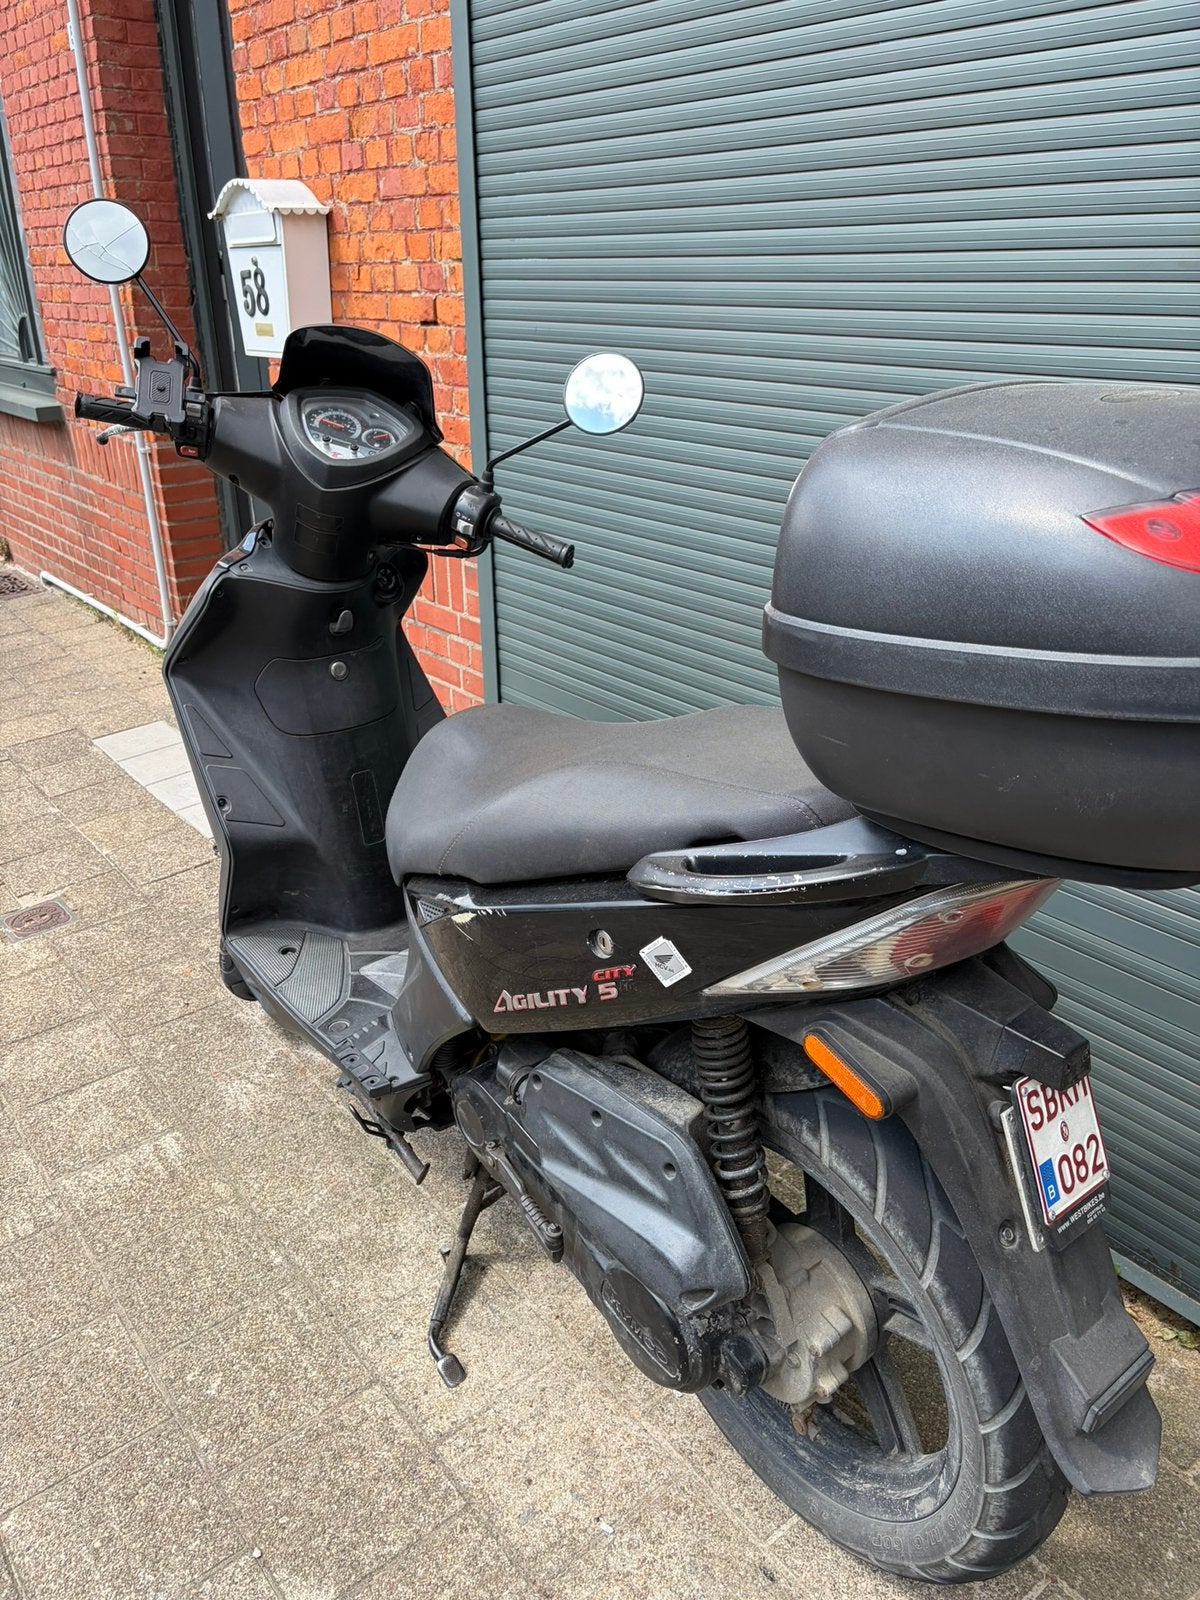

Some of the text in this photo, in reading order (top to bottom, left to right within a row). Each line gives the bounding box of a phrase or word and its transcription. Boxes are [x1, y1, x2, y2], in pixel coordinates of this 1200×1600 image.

[240, 267, 270, 318] 58
[592, 964, 637, 982] CITY
[493, 984, 588, 1013] AGILITY
[1058, 1133, 1105, 1195] 082
[1047, 1184, 1056, 1200] B
